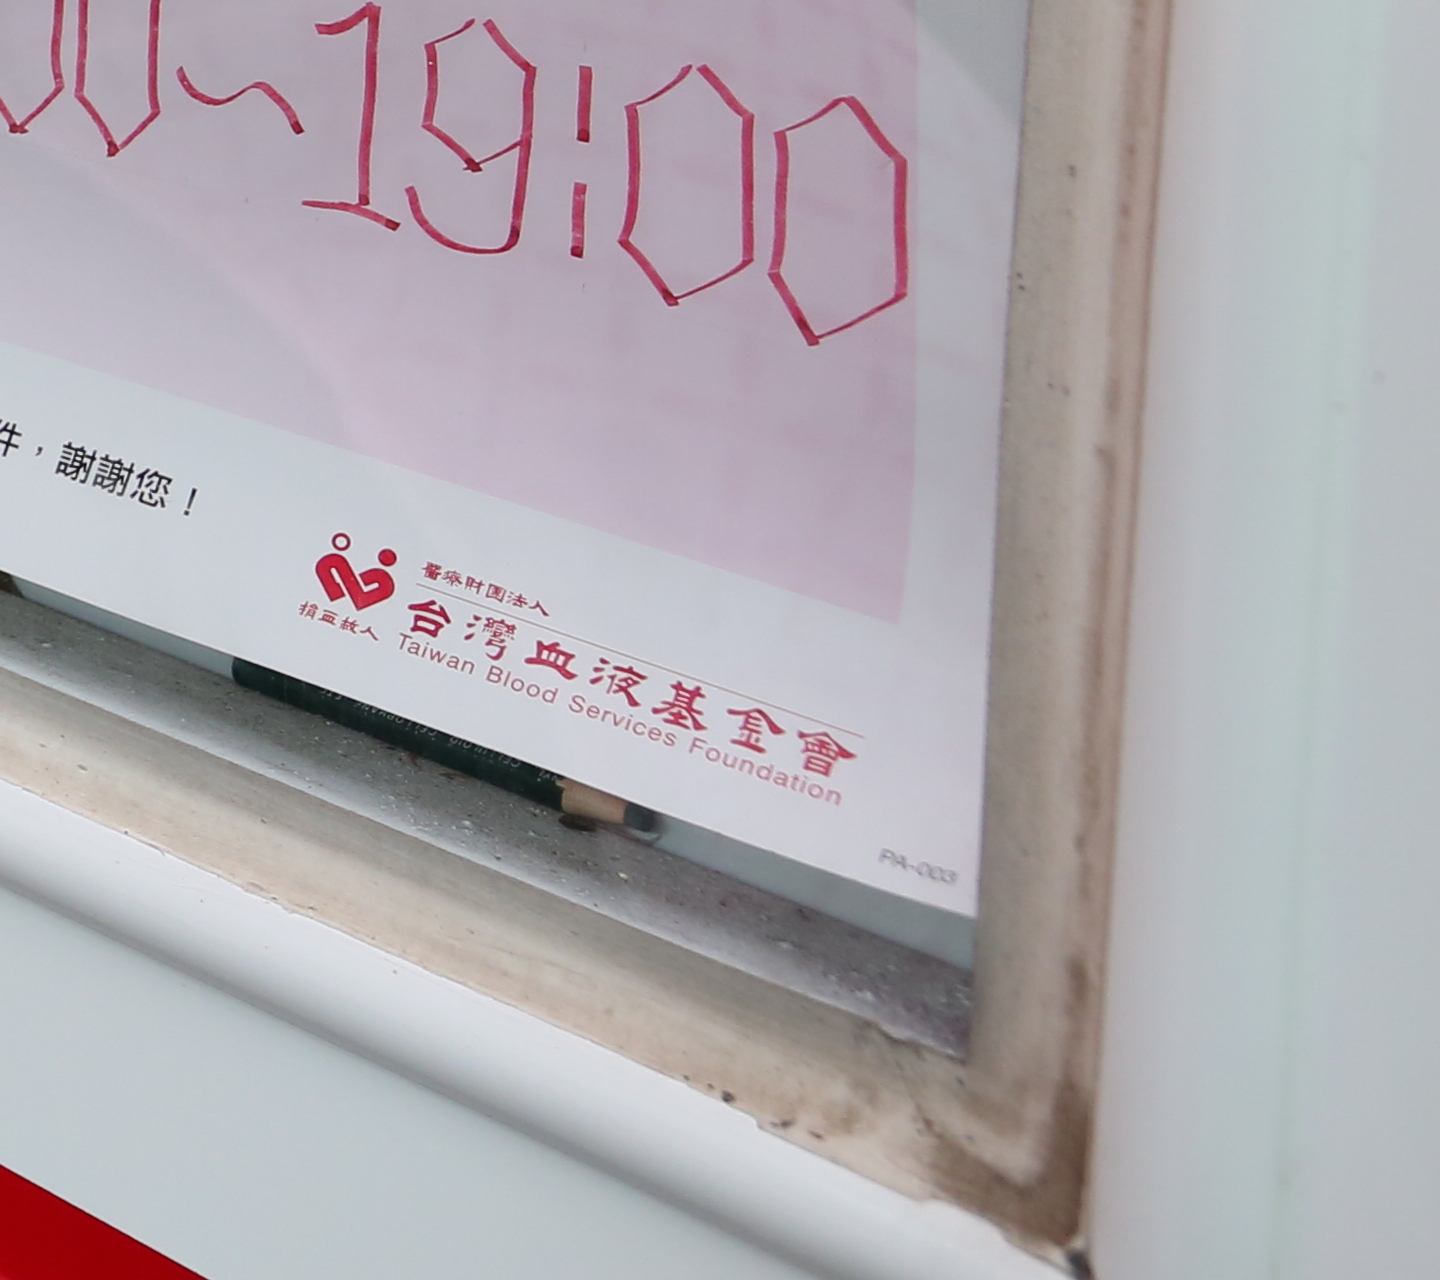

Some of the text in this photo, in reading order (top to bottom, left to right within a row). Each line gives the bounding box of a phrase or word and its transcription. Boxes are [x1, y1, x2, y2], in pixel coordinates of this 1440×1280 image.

[421, 561, 551, 618] 醫療財團法人
[398, 633, 843, 808] Taiwan Blood Services Foundation
[407, 598, 857, 779] 台灣血液基金會
